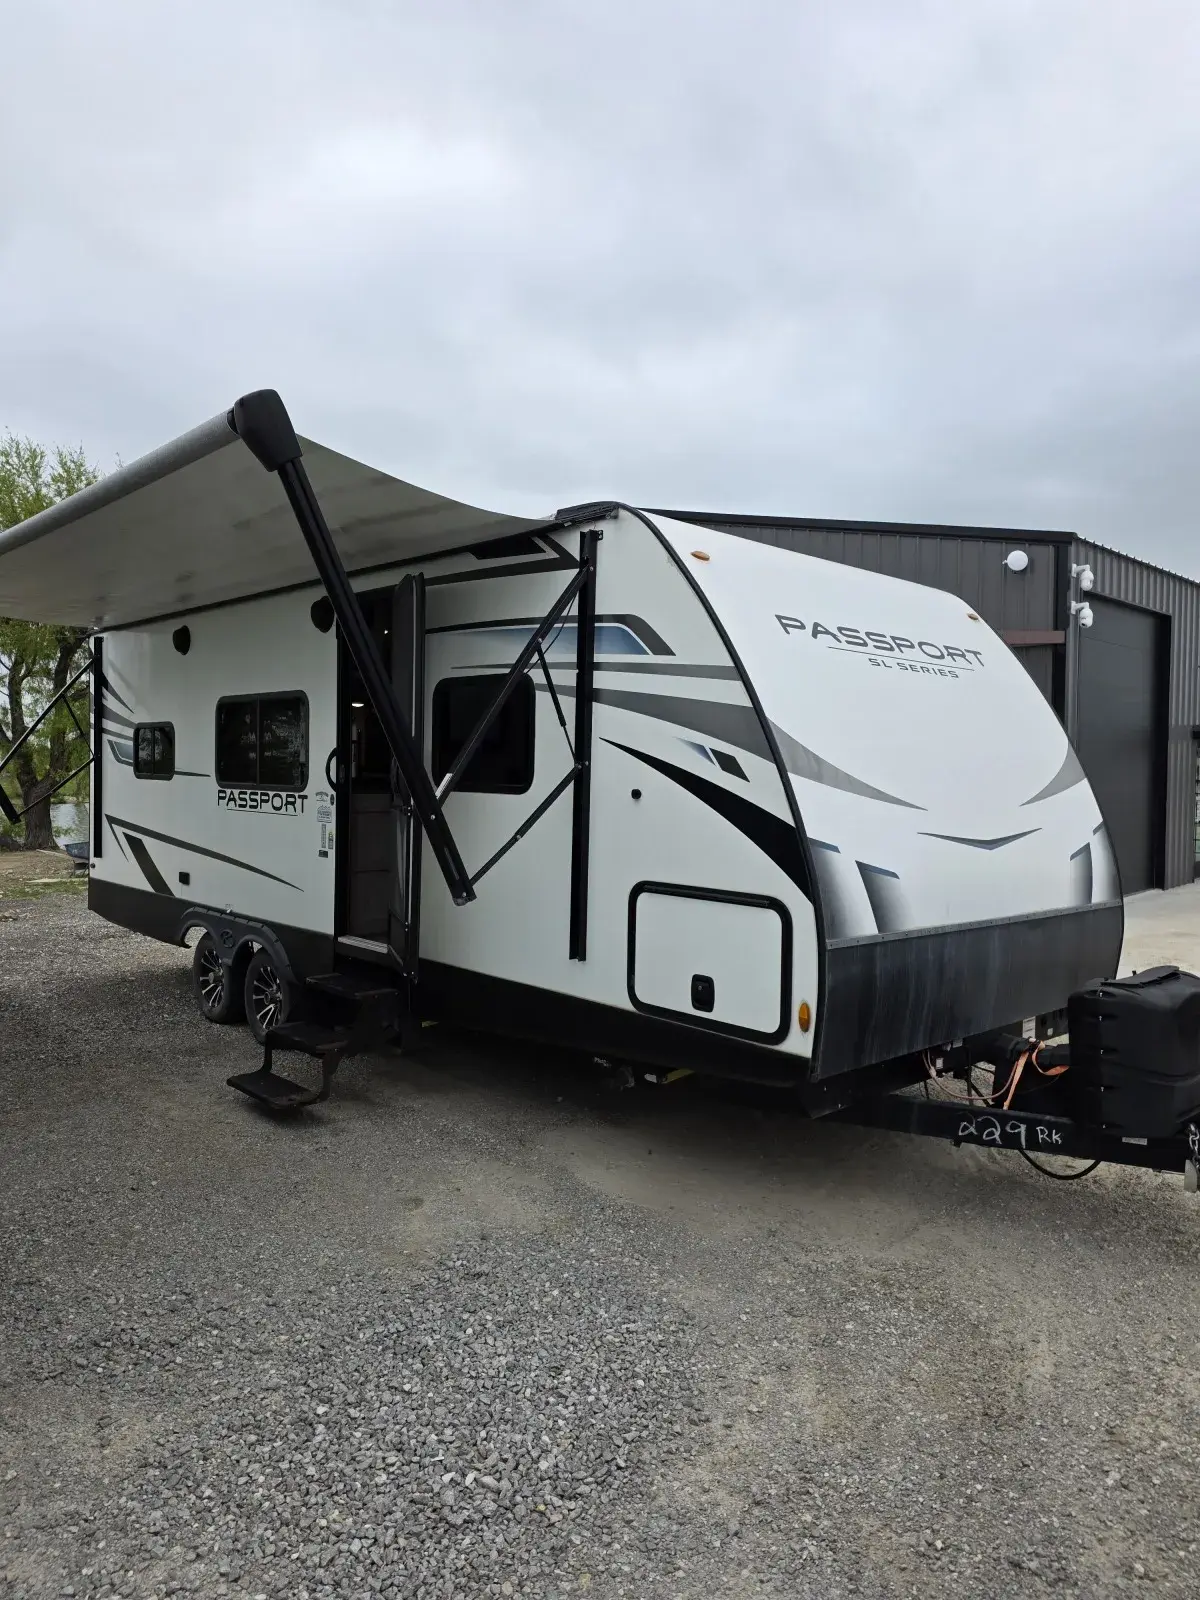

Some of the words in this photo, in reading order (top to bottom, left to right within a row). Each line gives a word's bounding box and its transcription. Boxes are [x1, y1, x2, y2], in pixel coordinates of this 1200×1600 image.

[774, 614, 985, 667] PASSPORT
[868, 658, 892, 669] SL
[896, 662, 959, 679] SERIES
[217, 789, 308, 814] PASSPORT
[958, 1111, 1027, 1149] 229
